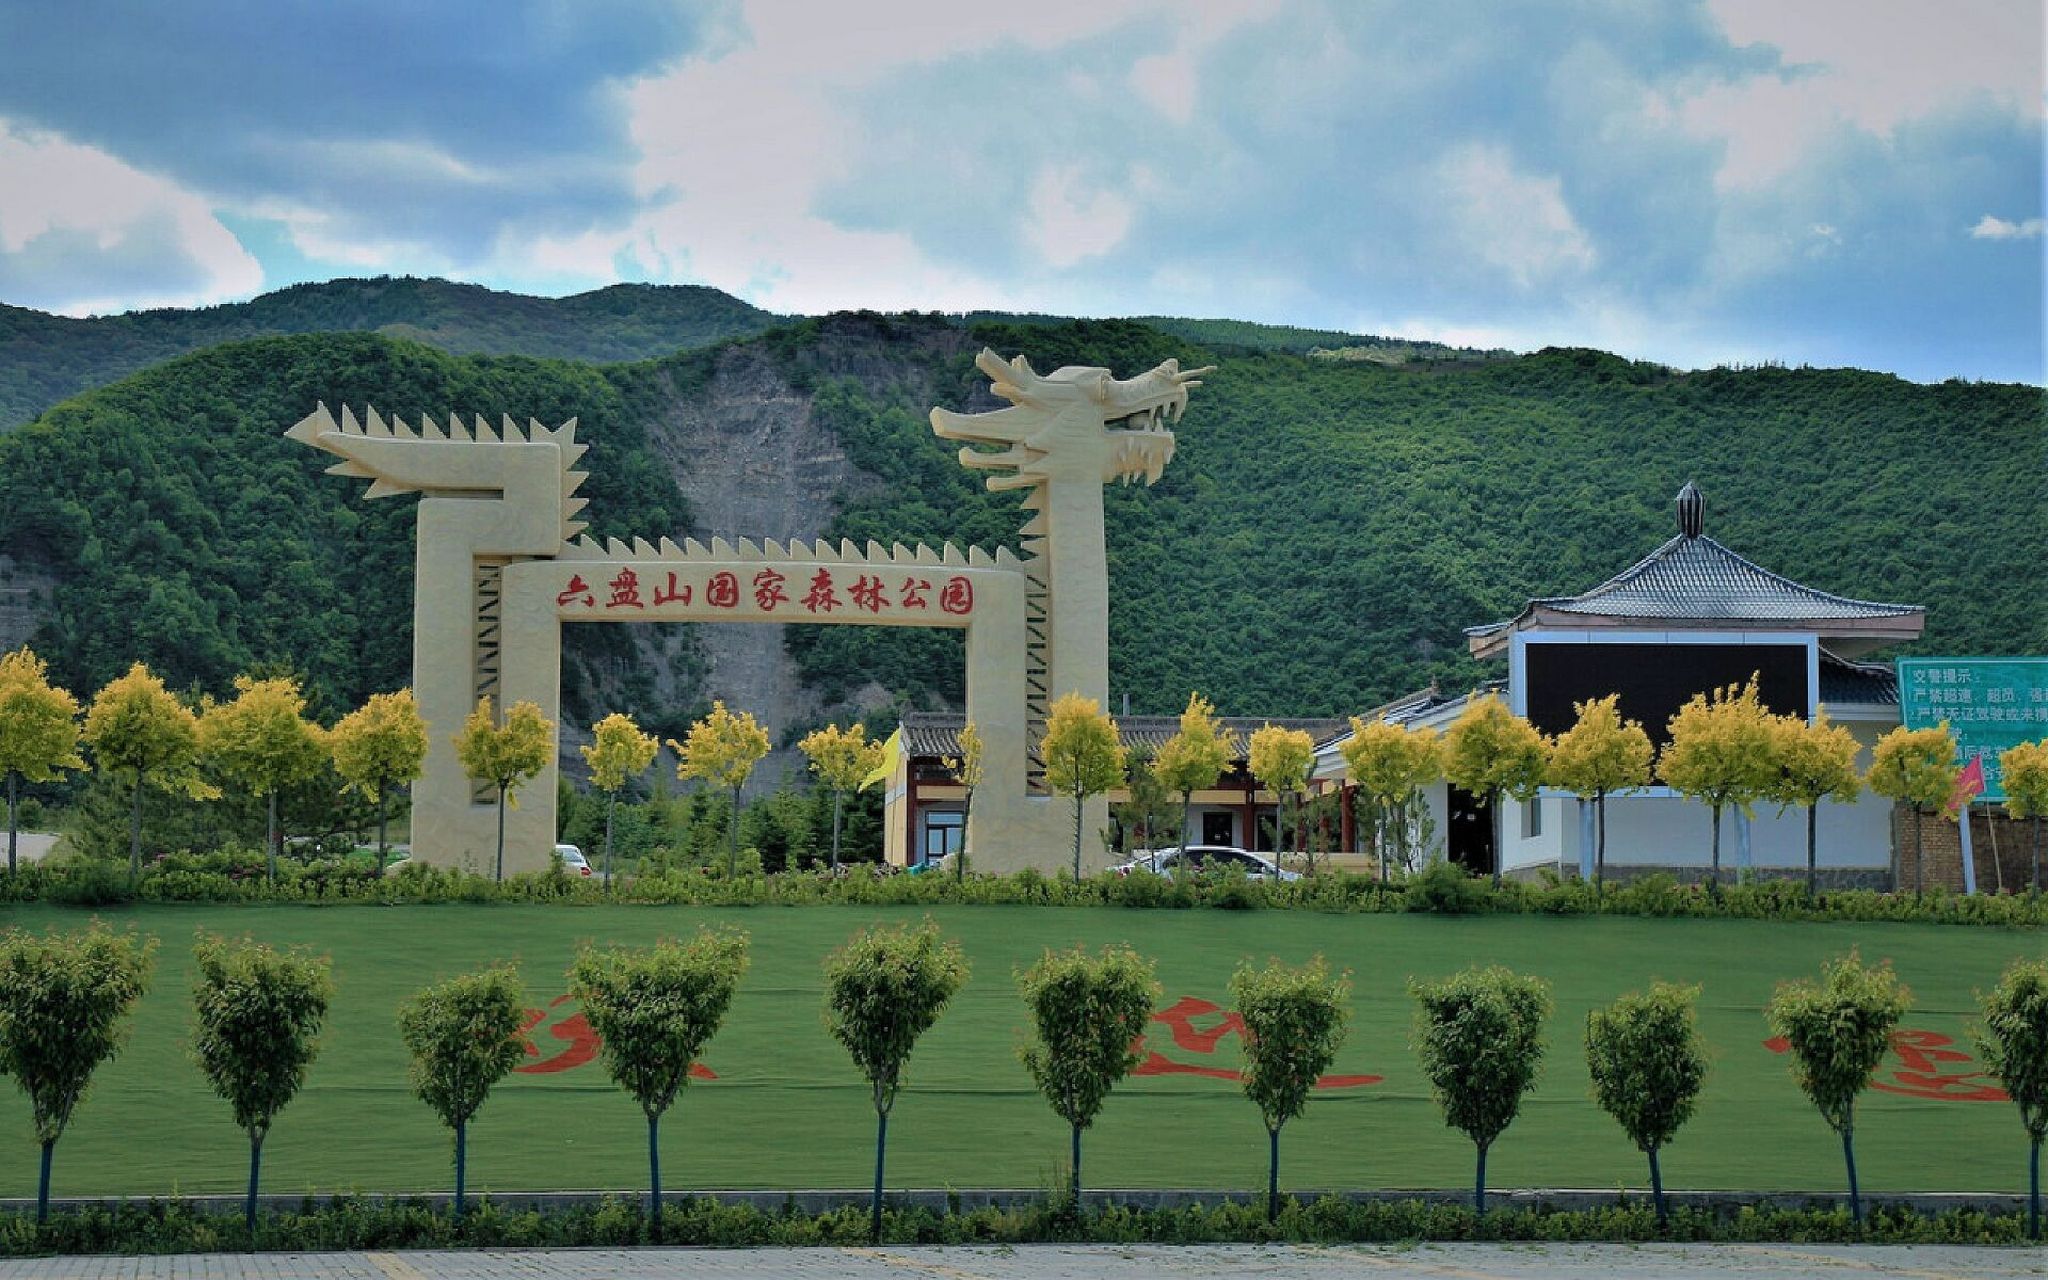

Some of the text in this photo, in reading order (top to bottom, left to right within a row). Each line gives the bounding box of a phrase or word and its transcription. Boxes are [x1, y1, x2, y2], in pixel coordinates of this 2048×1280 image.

[557, 567, 975, 615] 六盘山国家森林公园
